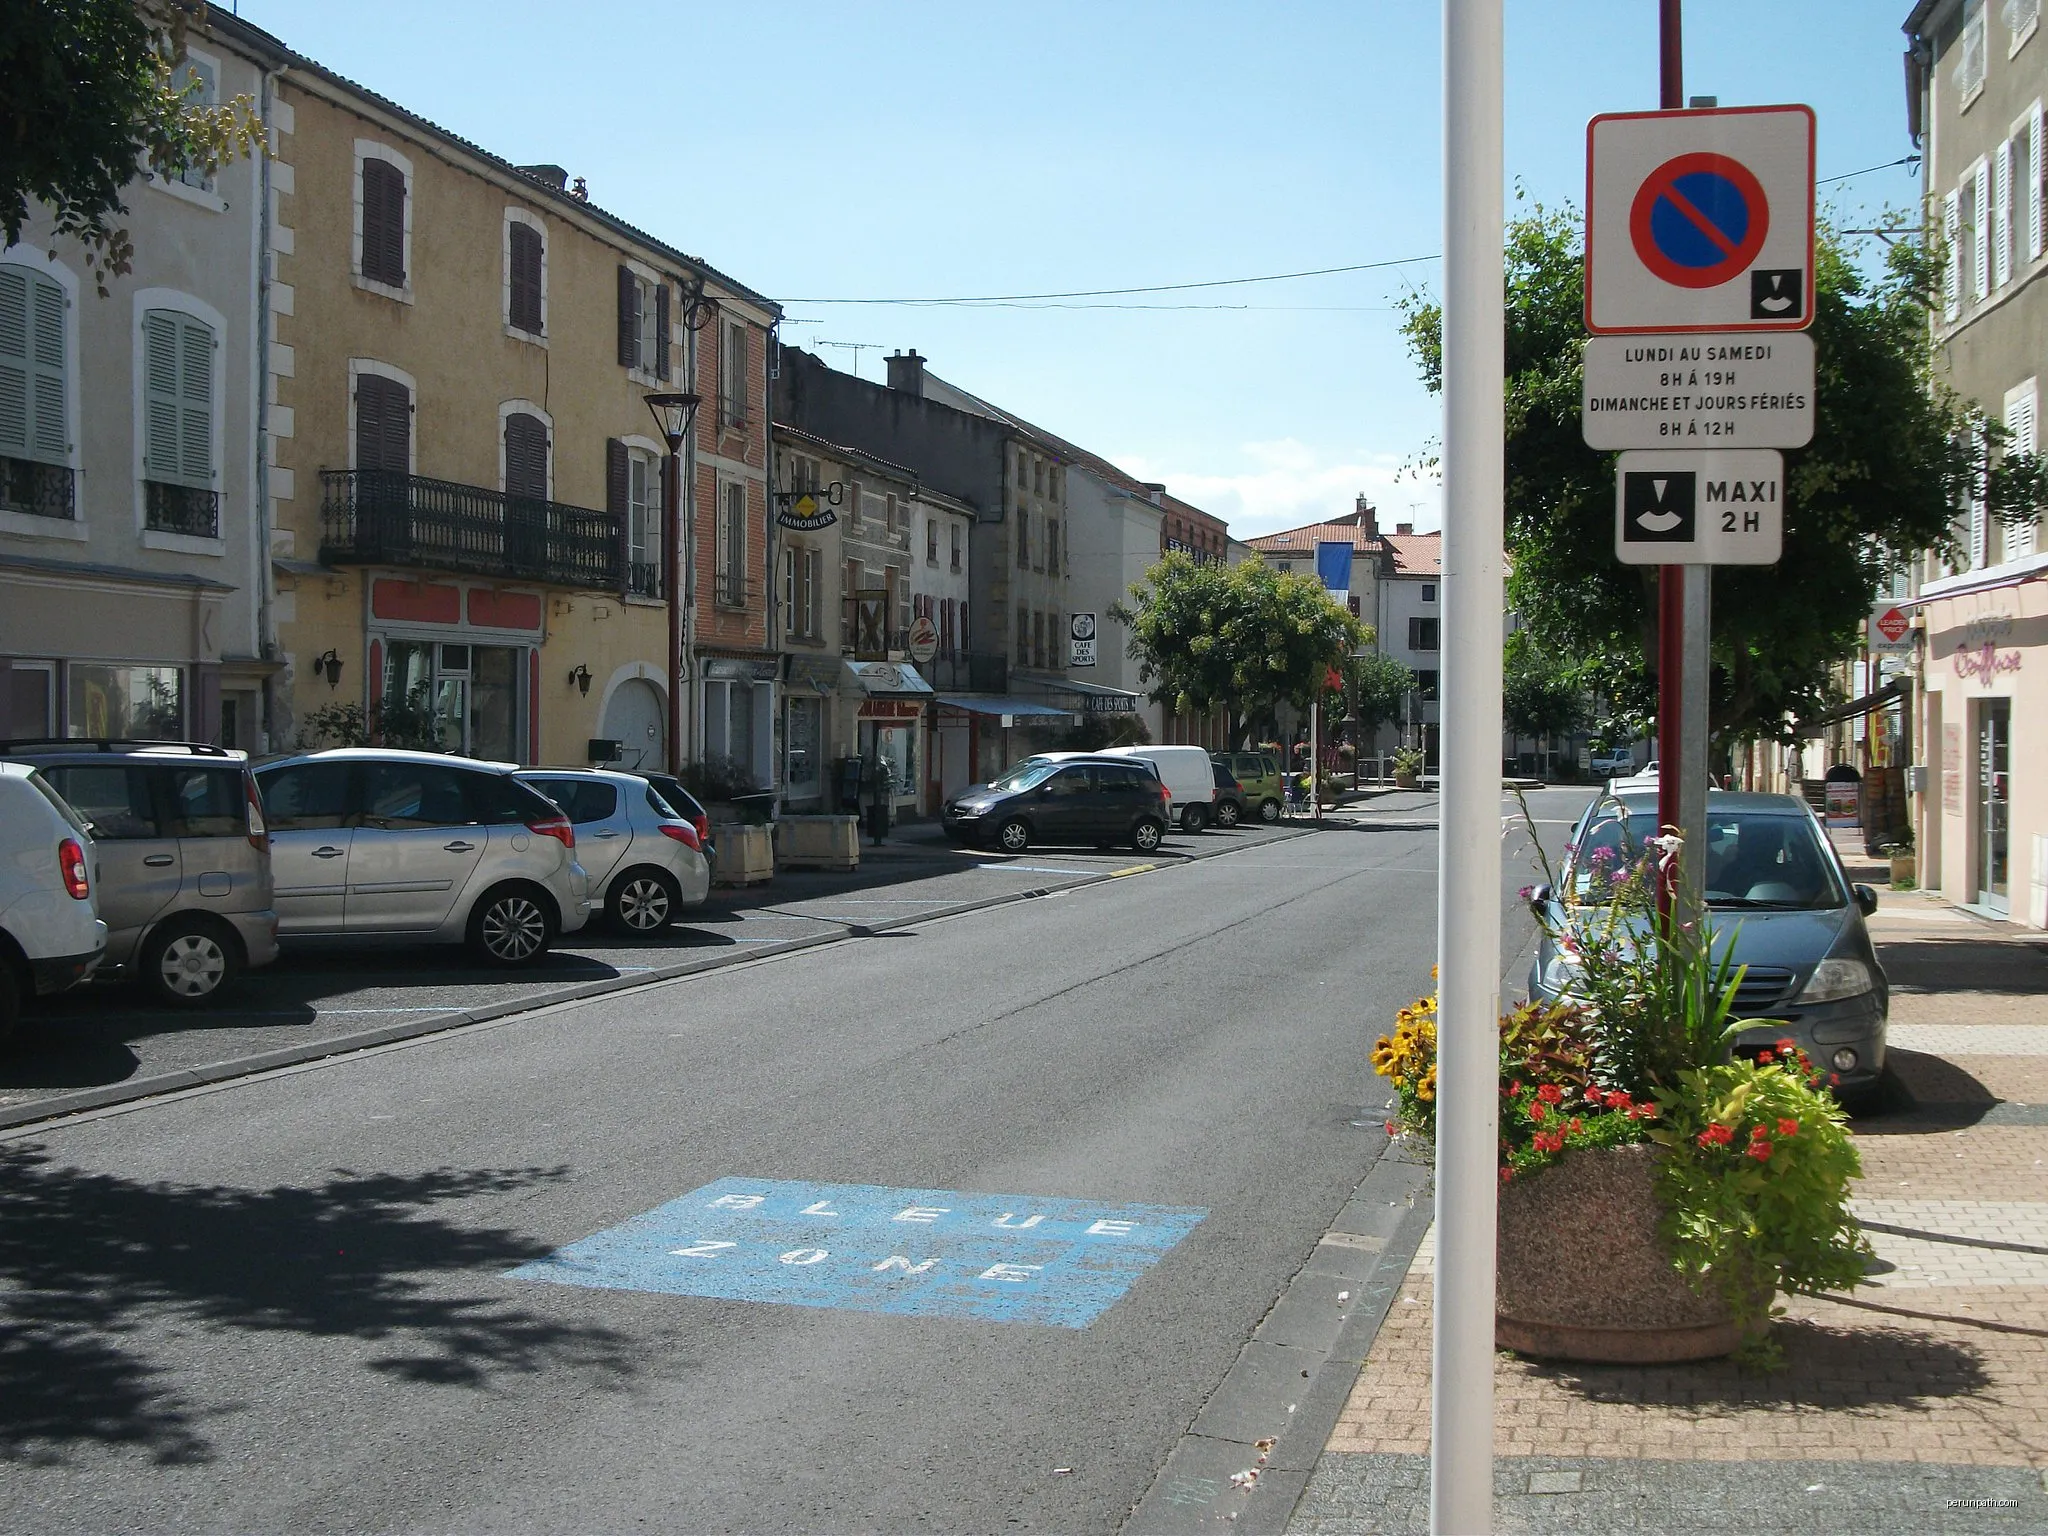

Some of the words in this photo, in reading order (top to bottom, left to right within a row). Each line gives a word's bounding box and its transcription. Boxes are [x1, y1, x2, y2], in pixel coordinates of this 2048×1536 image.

[1625, 348, 1674, 362] LUNDI
[1679, 347, 1701, 361] AU
[1707, 346, 1772, 360] SAMEDI
[1660, 373, 1682, 386] 8H
[1705, 372, 1736, 385] 19H
[1590, 397, 1669, 412] DIMANCHE
[1672, 396, 1691, 410] ET
[1695, 396, 1747, 410] JOURS
[1751, 392, 1806, 410] FÉRIÉS
[1659, 422, 1681, 436] 8H
[1704, 422, 1735, 435] 12H
[1706, 481, 1776, 502] MAXI
[780, 513, 833, 528] IMMOBILIER
[1721, 511, 1760, 533] 2H
[706, 1193, 1141, 1237] BLEUE
[668, 1240, 1044, 1283] ZONE
